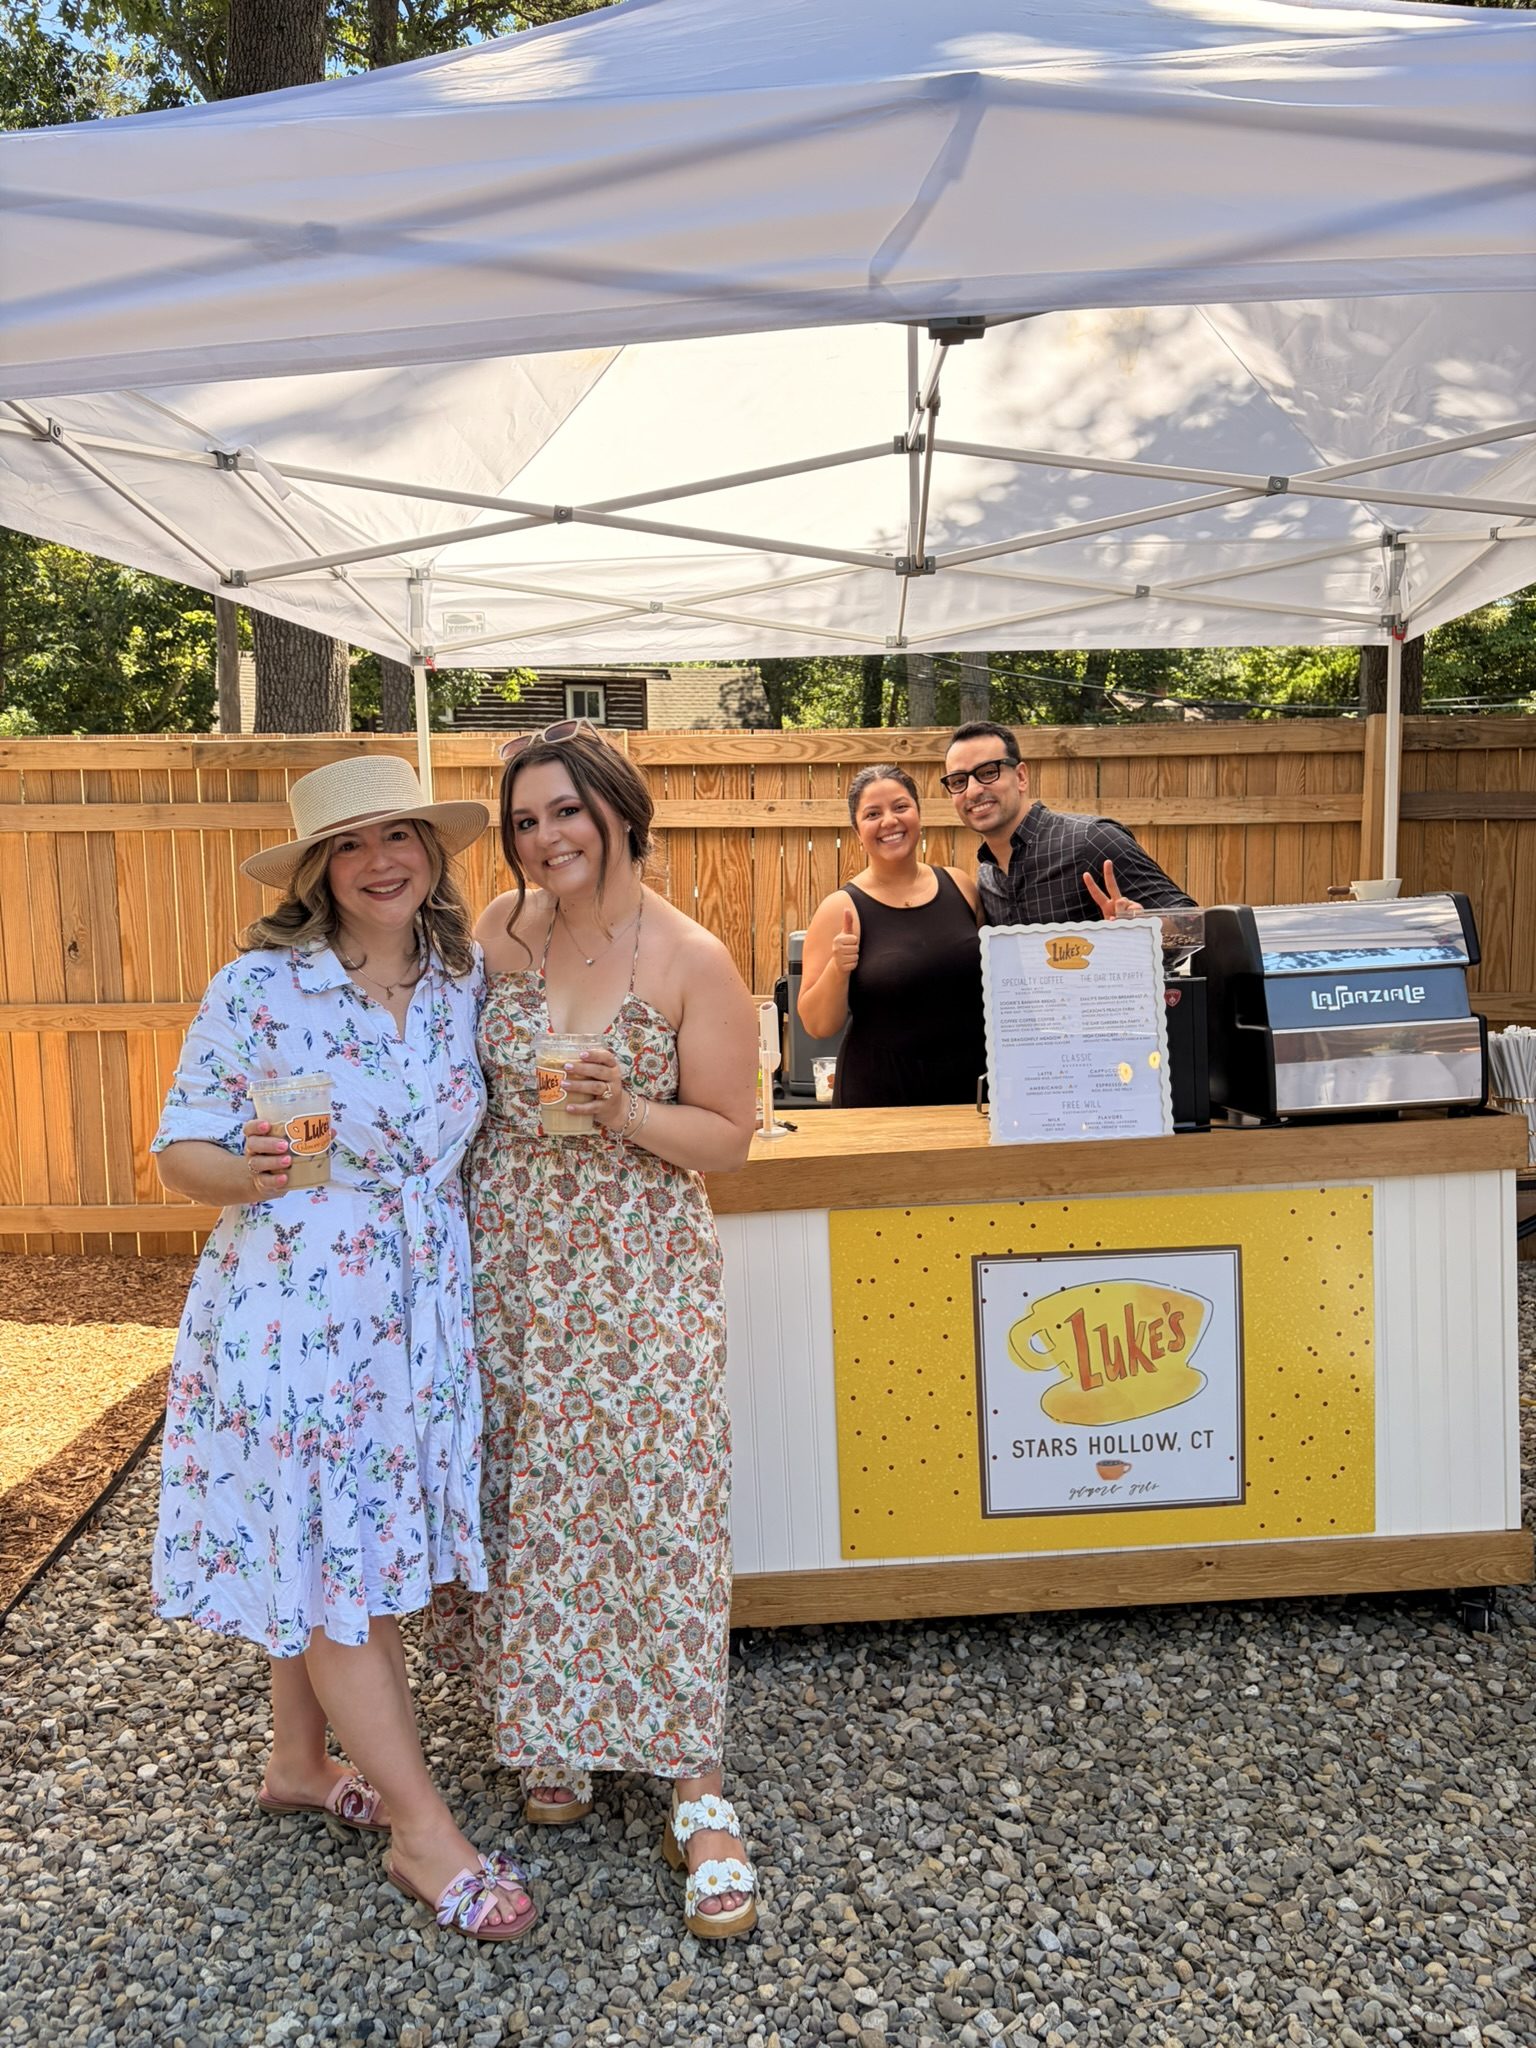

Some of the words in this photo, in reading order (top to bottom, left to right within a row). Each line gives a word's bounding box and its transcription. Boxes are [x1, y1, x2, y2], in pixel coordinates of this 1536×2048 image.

[1052, 943, 1080, 962] Luke's
[1001, 976, 1037, 987] SPECIALTY
[1040, 975, 1065, 985] COFFEE
[1080, 974, 1092, 983] THE
[1109, 972, 1122, 981] TEA
[1123, 971, 1144, 980] PARTY
[1061, 1053, 1093, 1062] CLASSIC
[1061, 1101, 1080, 1109] FREE
[1083, 1100, 1101, 1108] WILL
[1063, 1301, 1186, 1392] Luke's
[1012, 1437, 1078, 1459] STARS
[1088, 1431, 1182, 1455] HOLLOW,
[1191, 1430, 1214, 1449] CT
[1068, 1483, 1124, 1500] gilmore
[1130, 1481, 1160, 1496] girls
